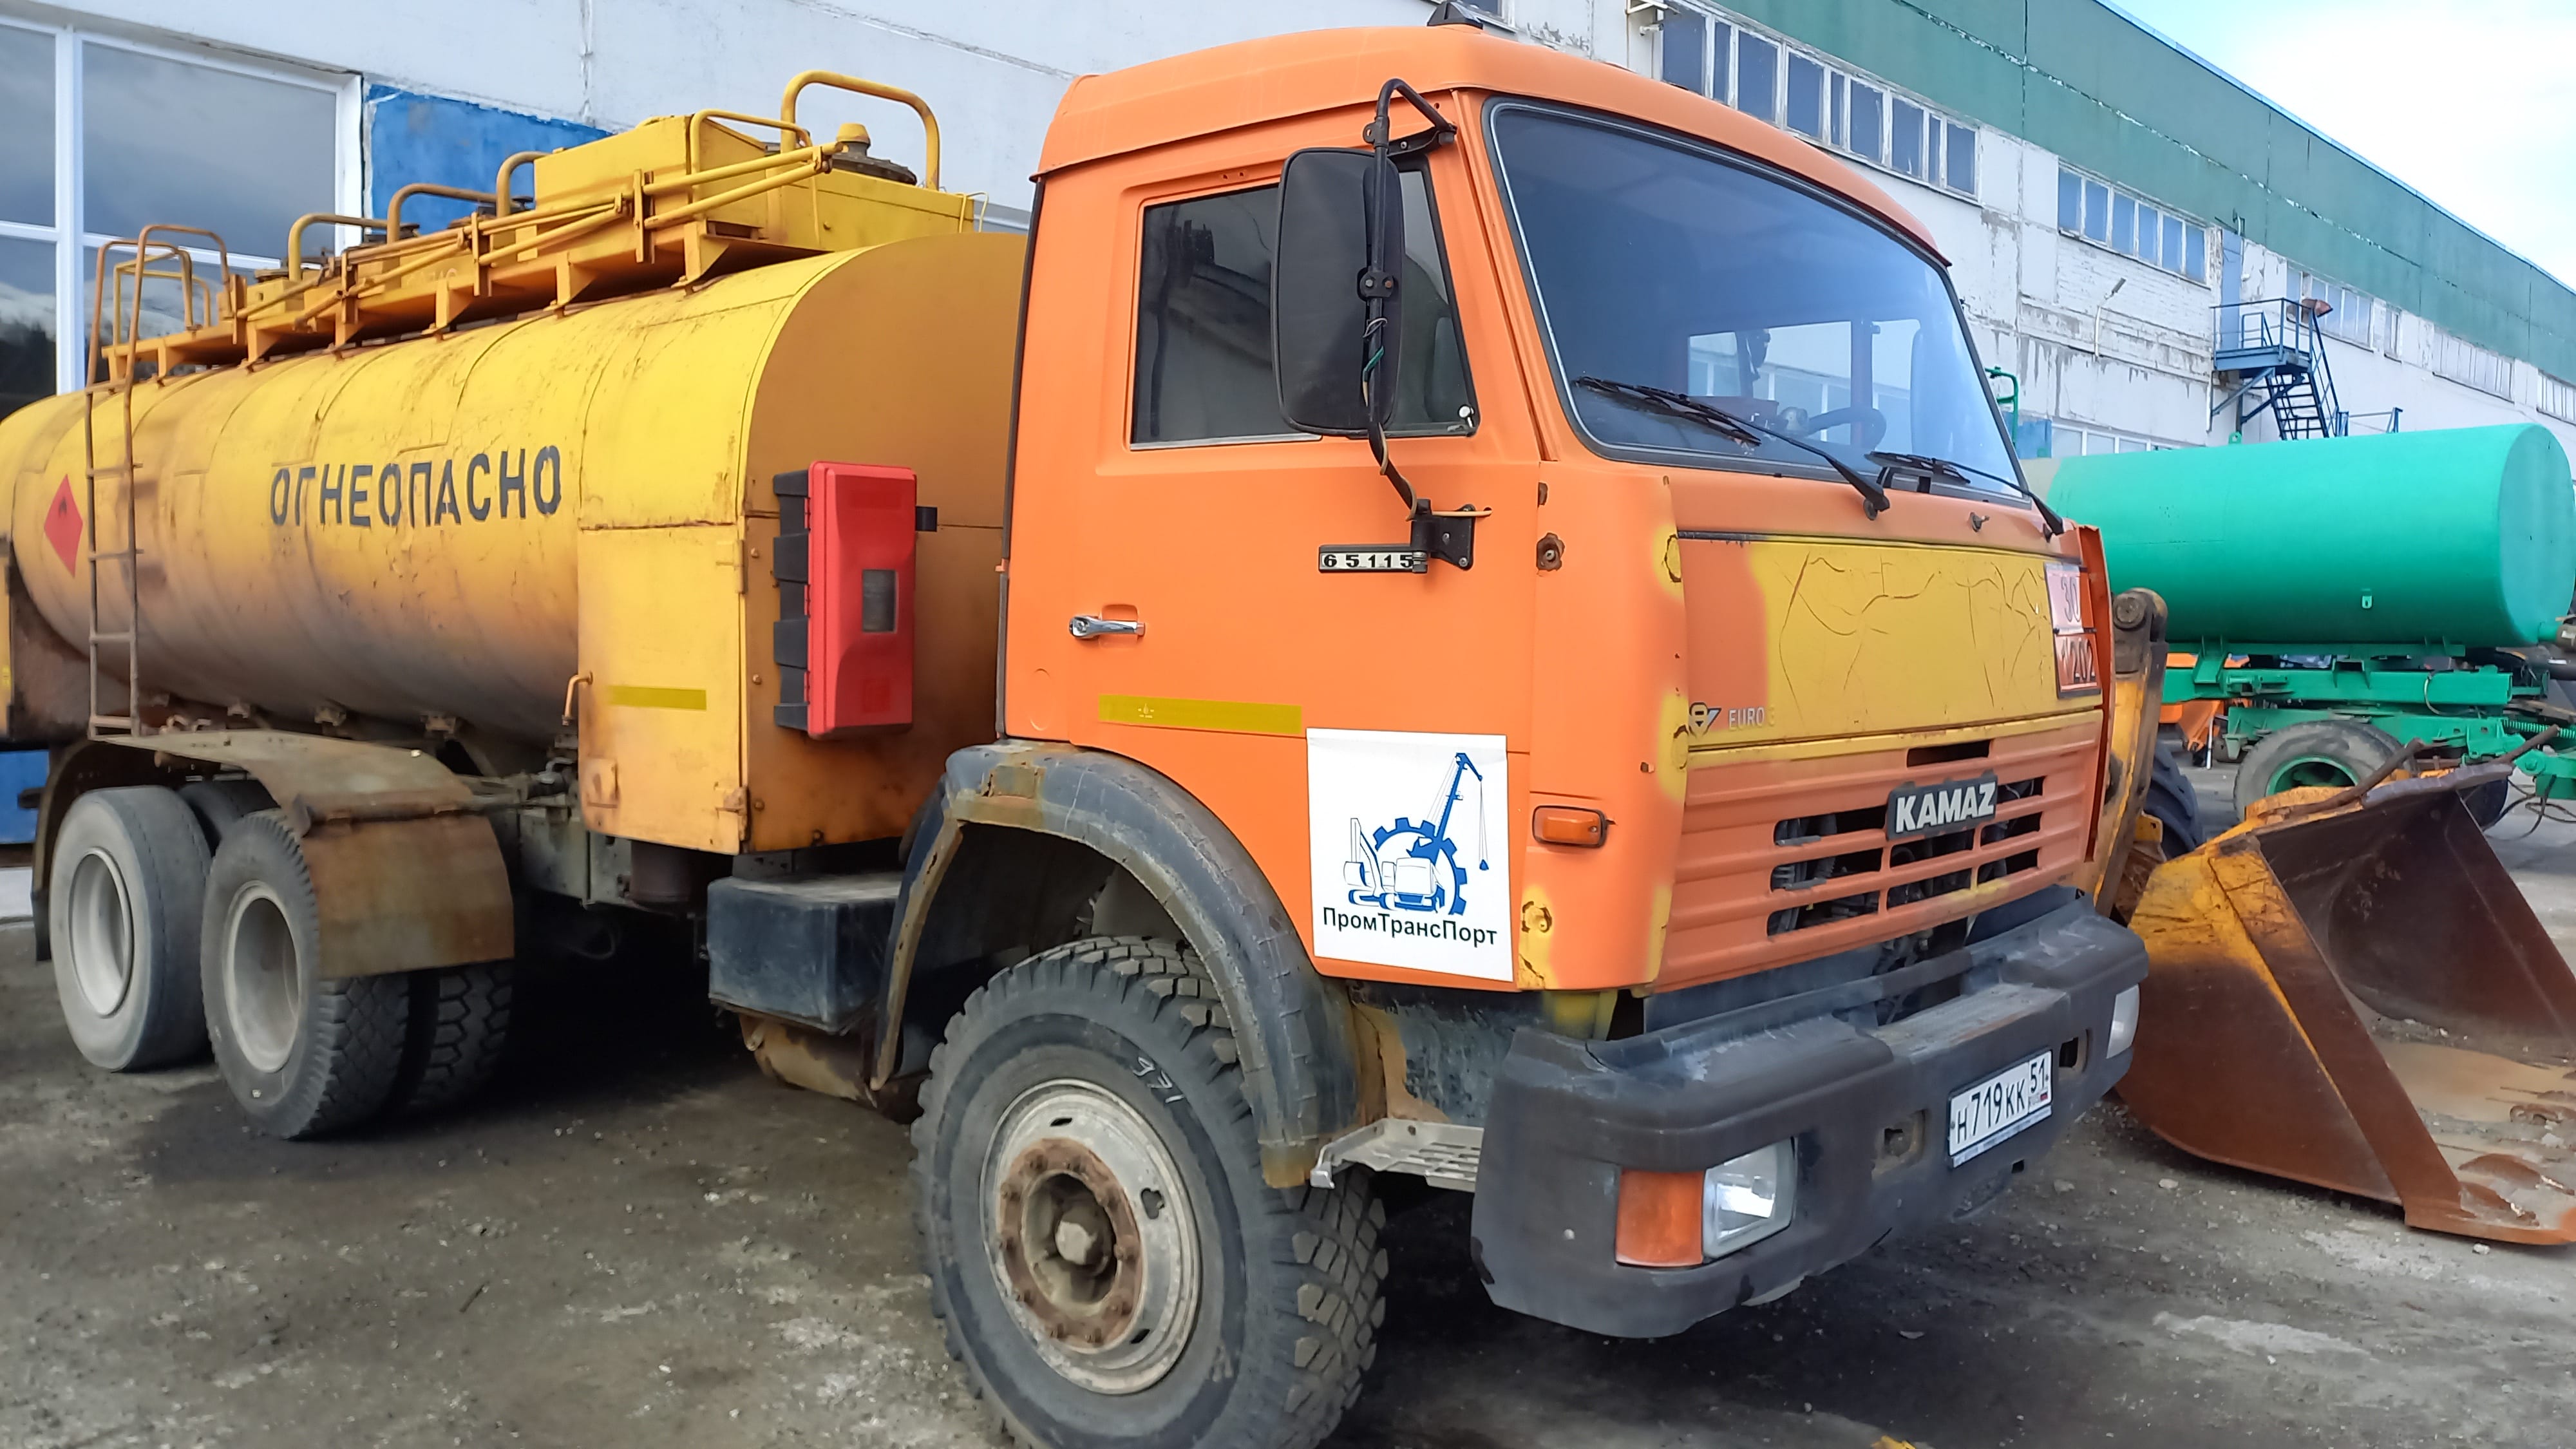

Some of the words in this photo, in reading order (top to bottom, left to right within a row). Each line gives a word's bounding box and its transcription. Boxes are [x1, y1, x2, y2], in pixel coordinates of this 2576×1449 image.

[270, 445, 561, 528] ОГНЕОПАСНО
[1323, 554, 1414, 567] 65115
[2061, 576, 2081, 623] 30
[1729, 706, 1765, 731] EURO
[1895, 781, 1996, 833] KAMAZ
[1323, 907, 1497, 947] ПромТрансПорт
[2030, 1058, 2045, 1094] 51
